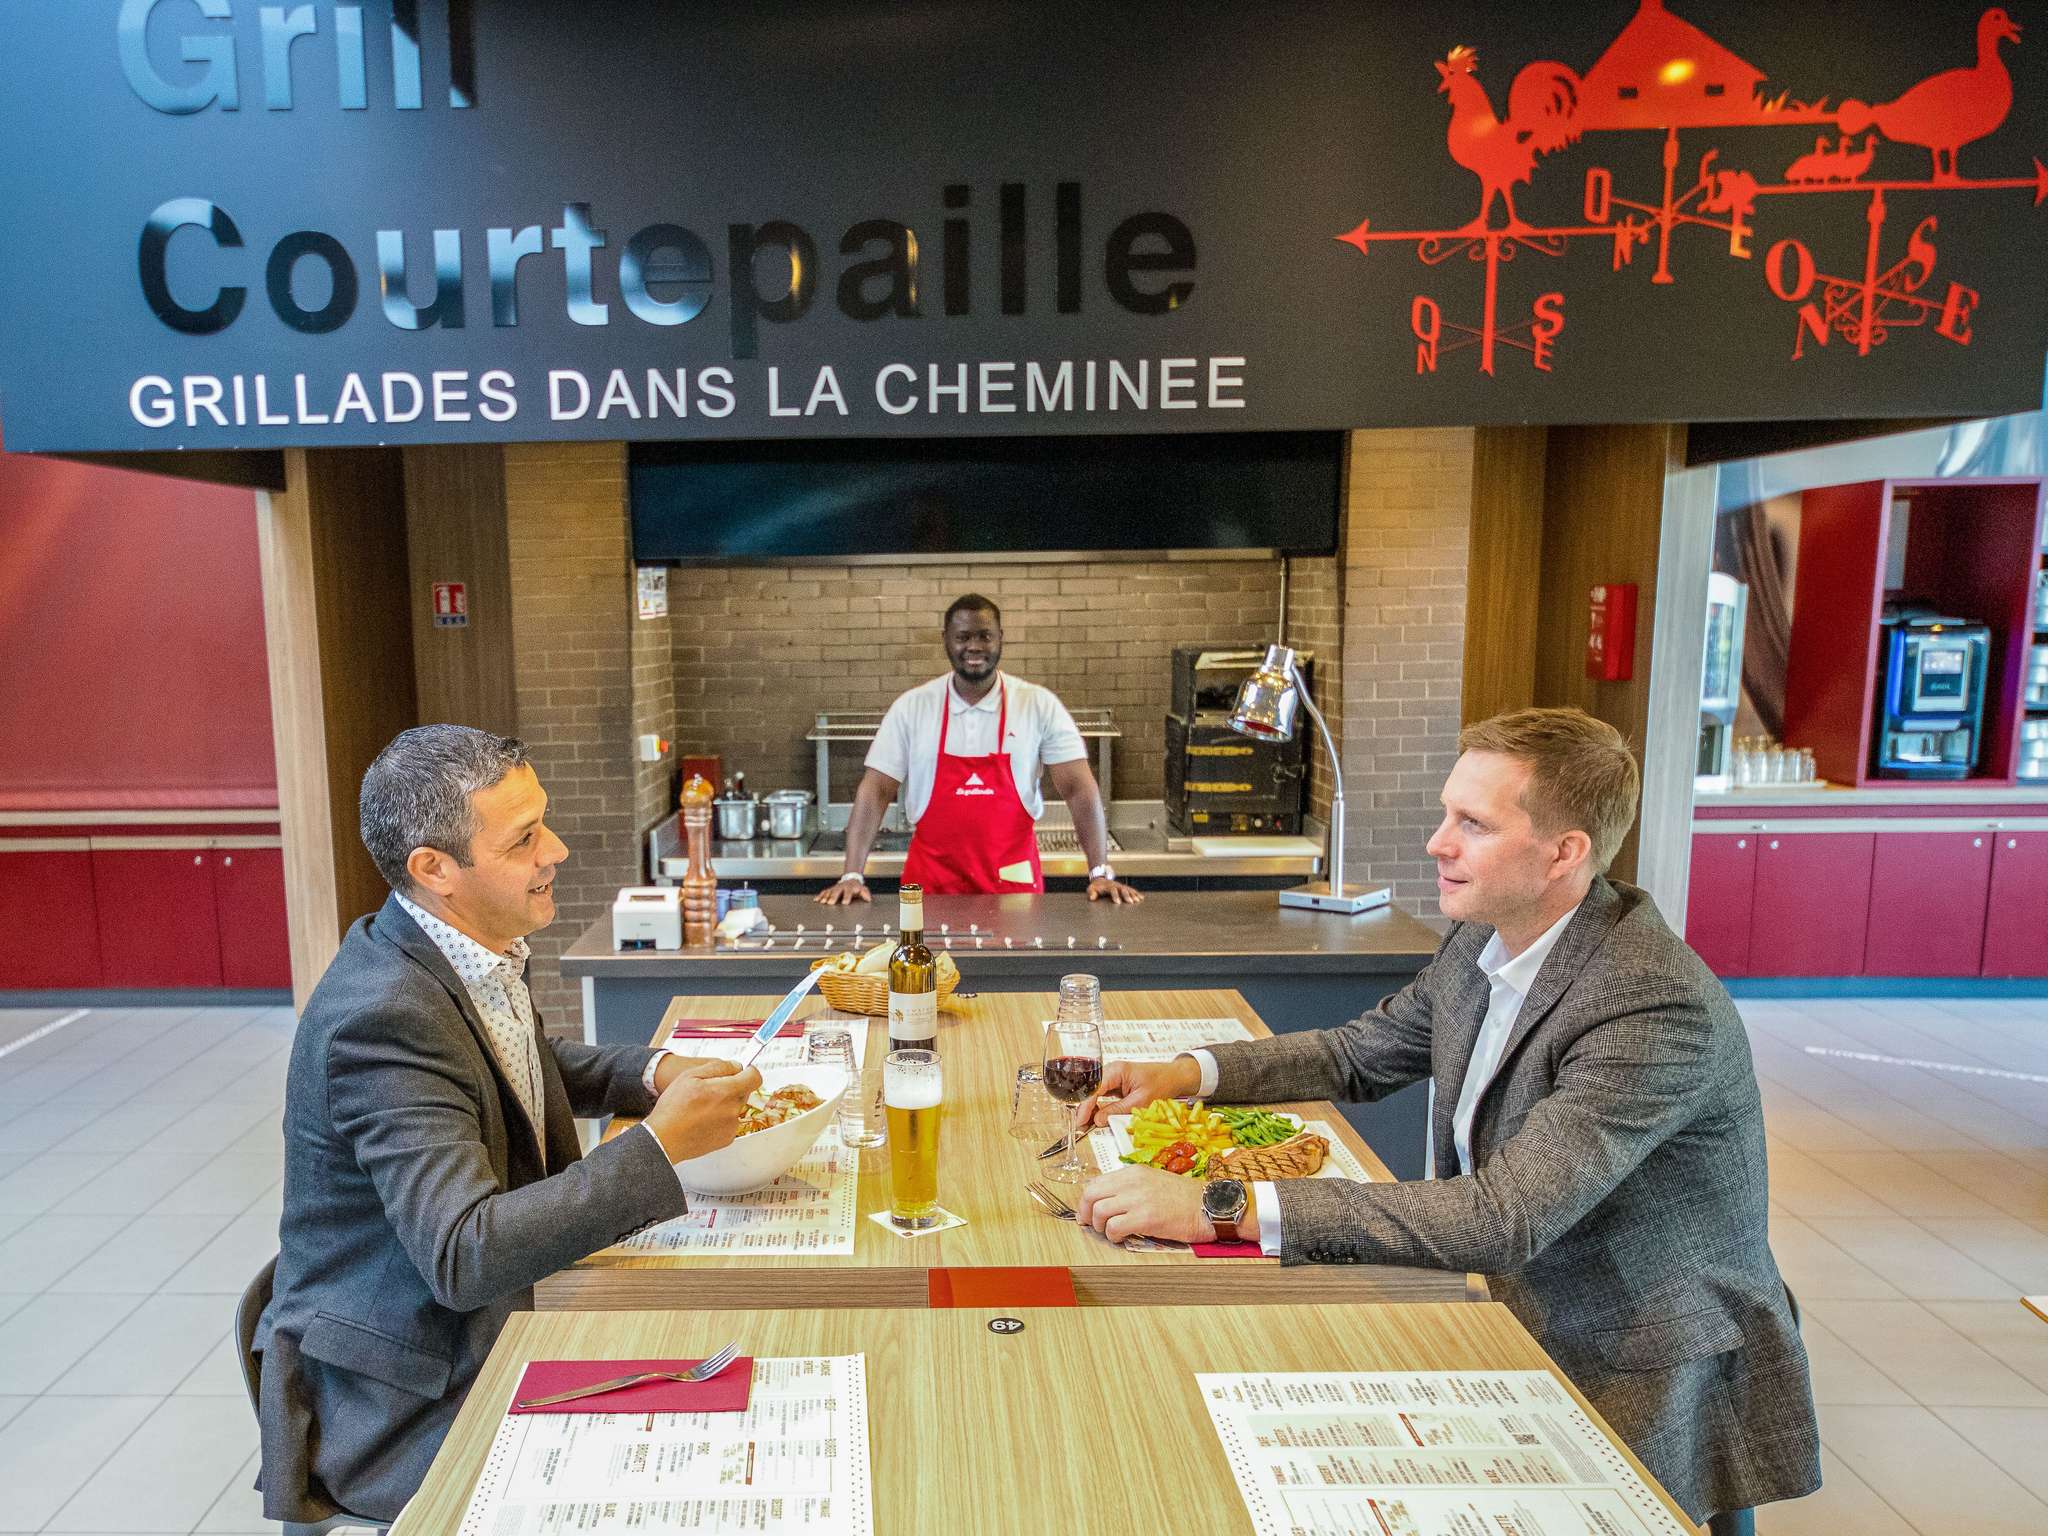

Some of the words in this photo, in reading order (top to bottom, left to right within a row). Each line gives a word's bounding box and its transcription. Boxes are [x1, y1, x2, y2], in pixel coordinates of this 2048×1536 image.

[117, 0, 477, 114] Grill
[138, 181, 1200, 360] Courtepaille
[129, 369, 518, 429] GRILLADES
[548, 366, 736, 422] DANS
[768, 365, 848, 418] LA
[875, 356, 1247, 416] CHEMINEE
